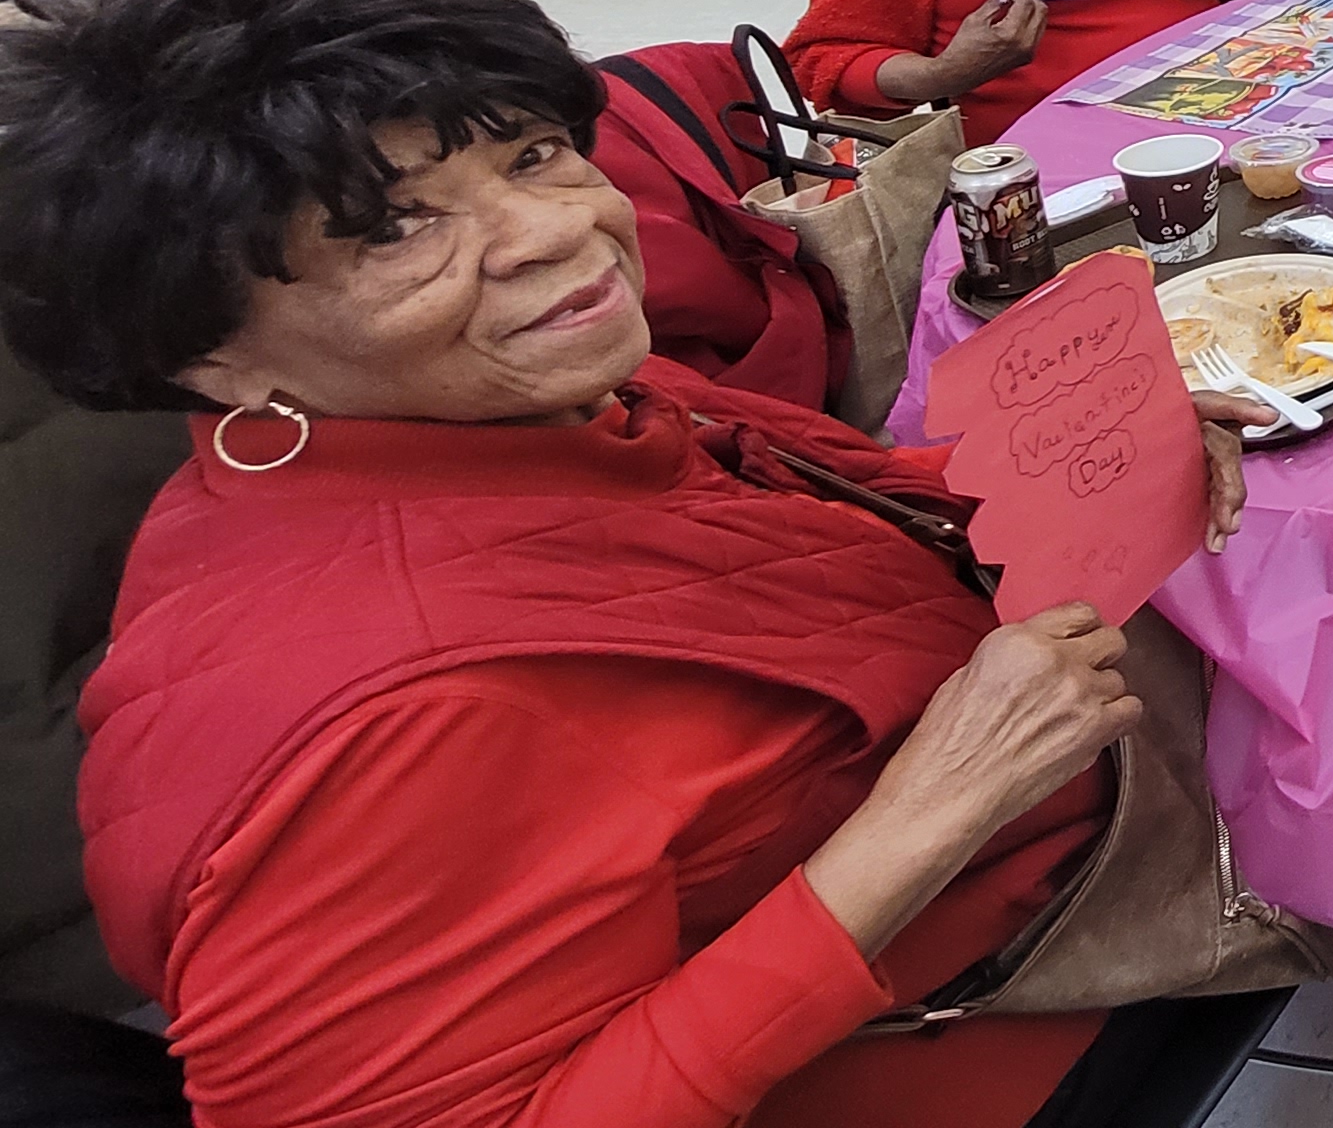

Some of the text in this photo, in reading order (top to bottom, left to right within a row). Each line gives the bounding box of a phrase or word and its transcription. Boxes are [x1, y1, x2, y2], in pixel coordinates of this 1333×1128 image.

[1012, 234, 1036, 251] ROOT
[1005, 320, 1114, 393] Happy
[1080, 447, 1127, 484] Day
